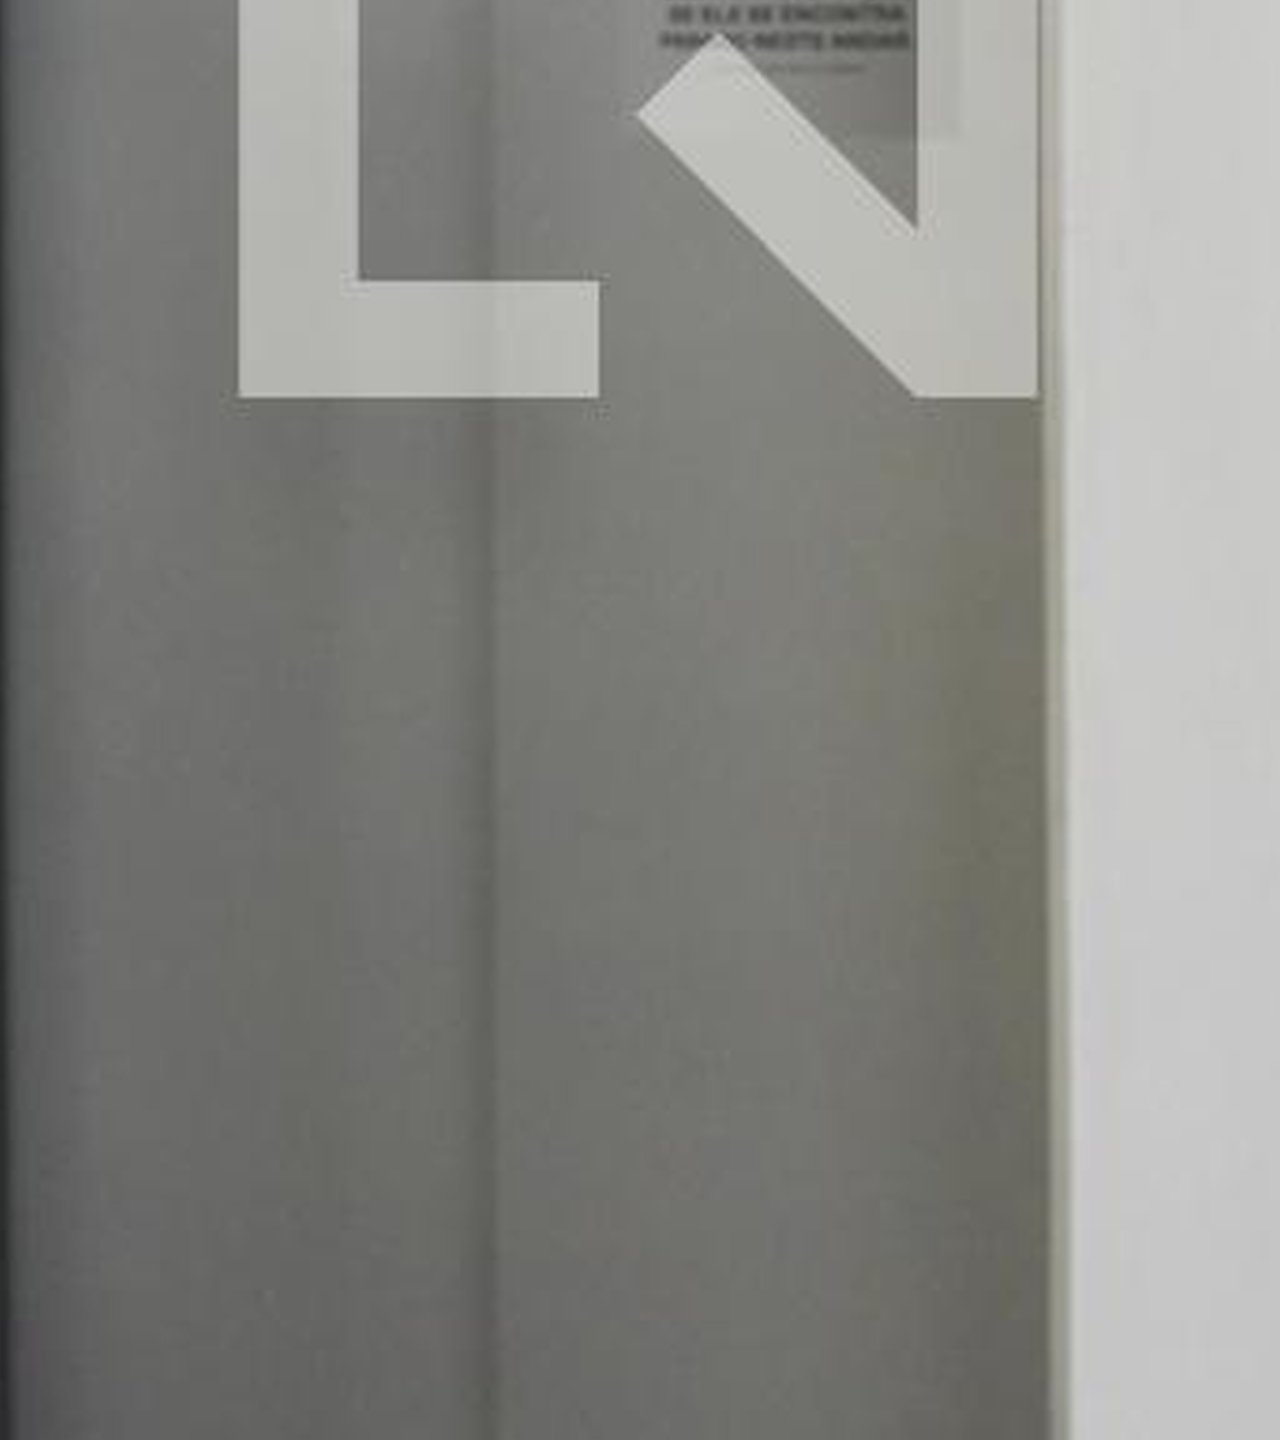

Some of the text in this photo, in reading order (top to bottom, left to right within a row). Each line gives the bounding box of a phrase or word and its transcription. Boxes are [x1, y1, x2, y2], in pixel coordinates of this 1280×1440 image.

[669, 4, 907, 24] SE ELE SE ENCONTRA
[754, 31, 823, 51] NESTE
[831, 31, 910, 50] ANDAR
